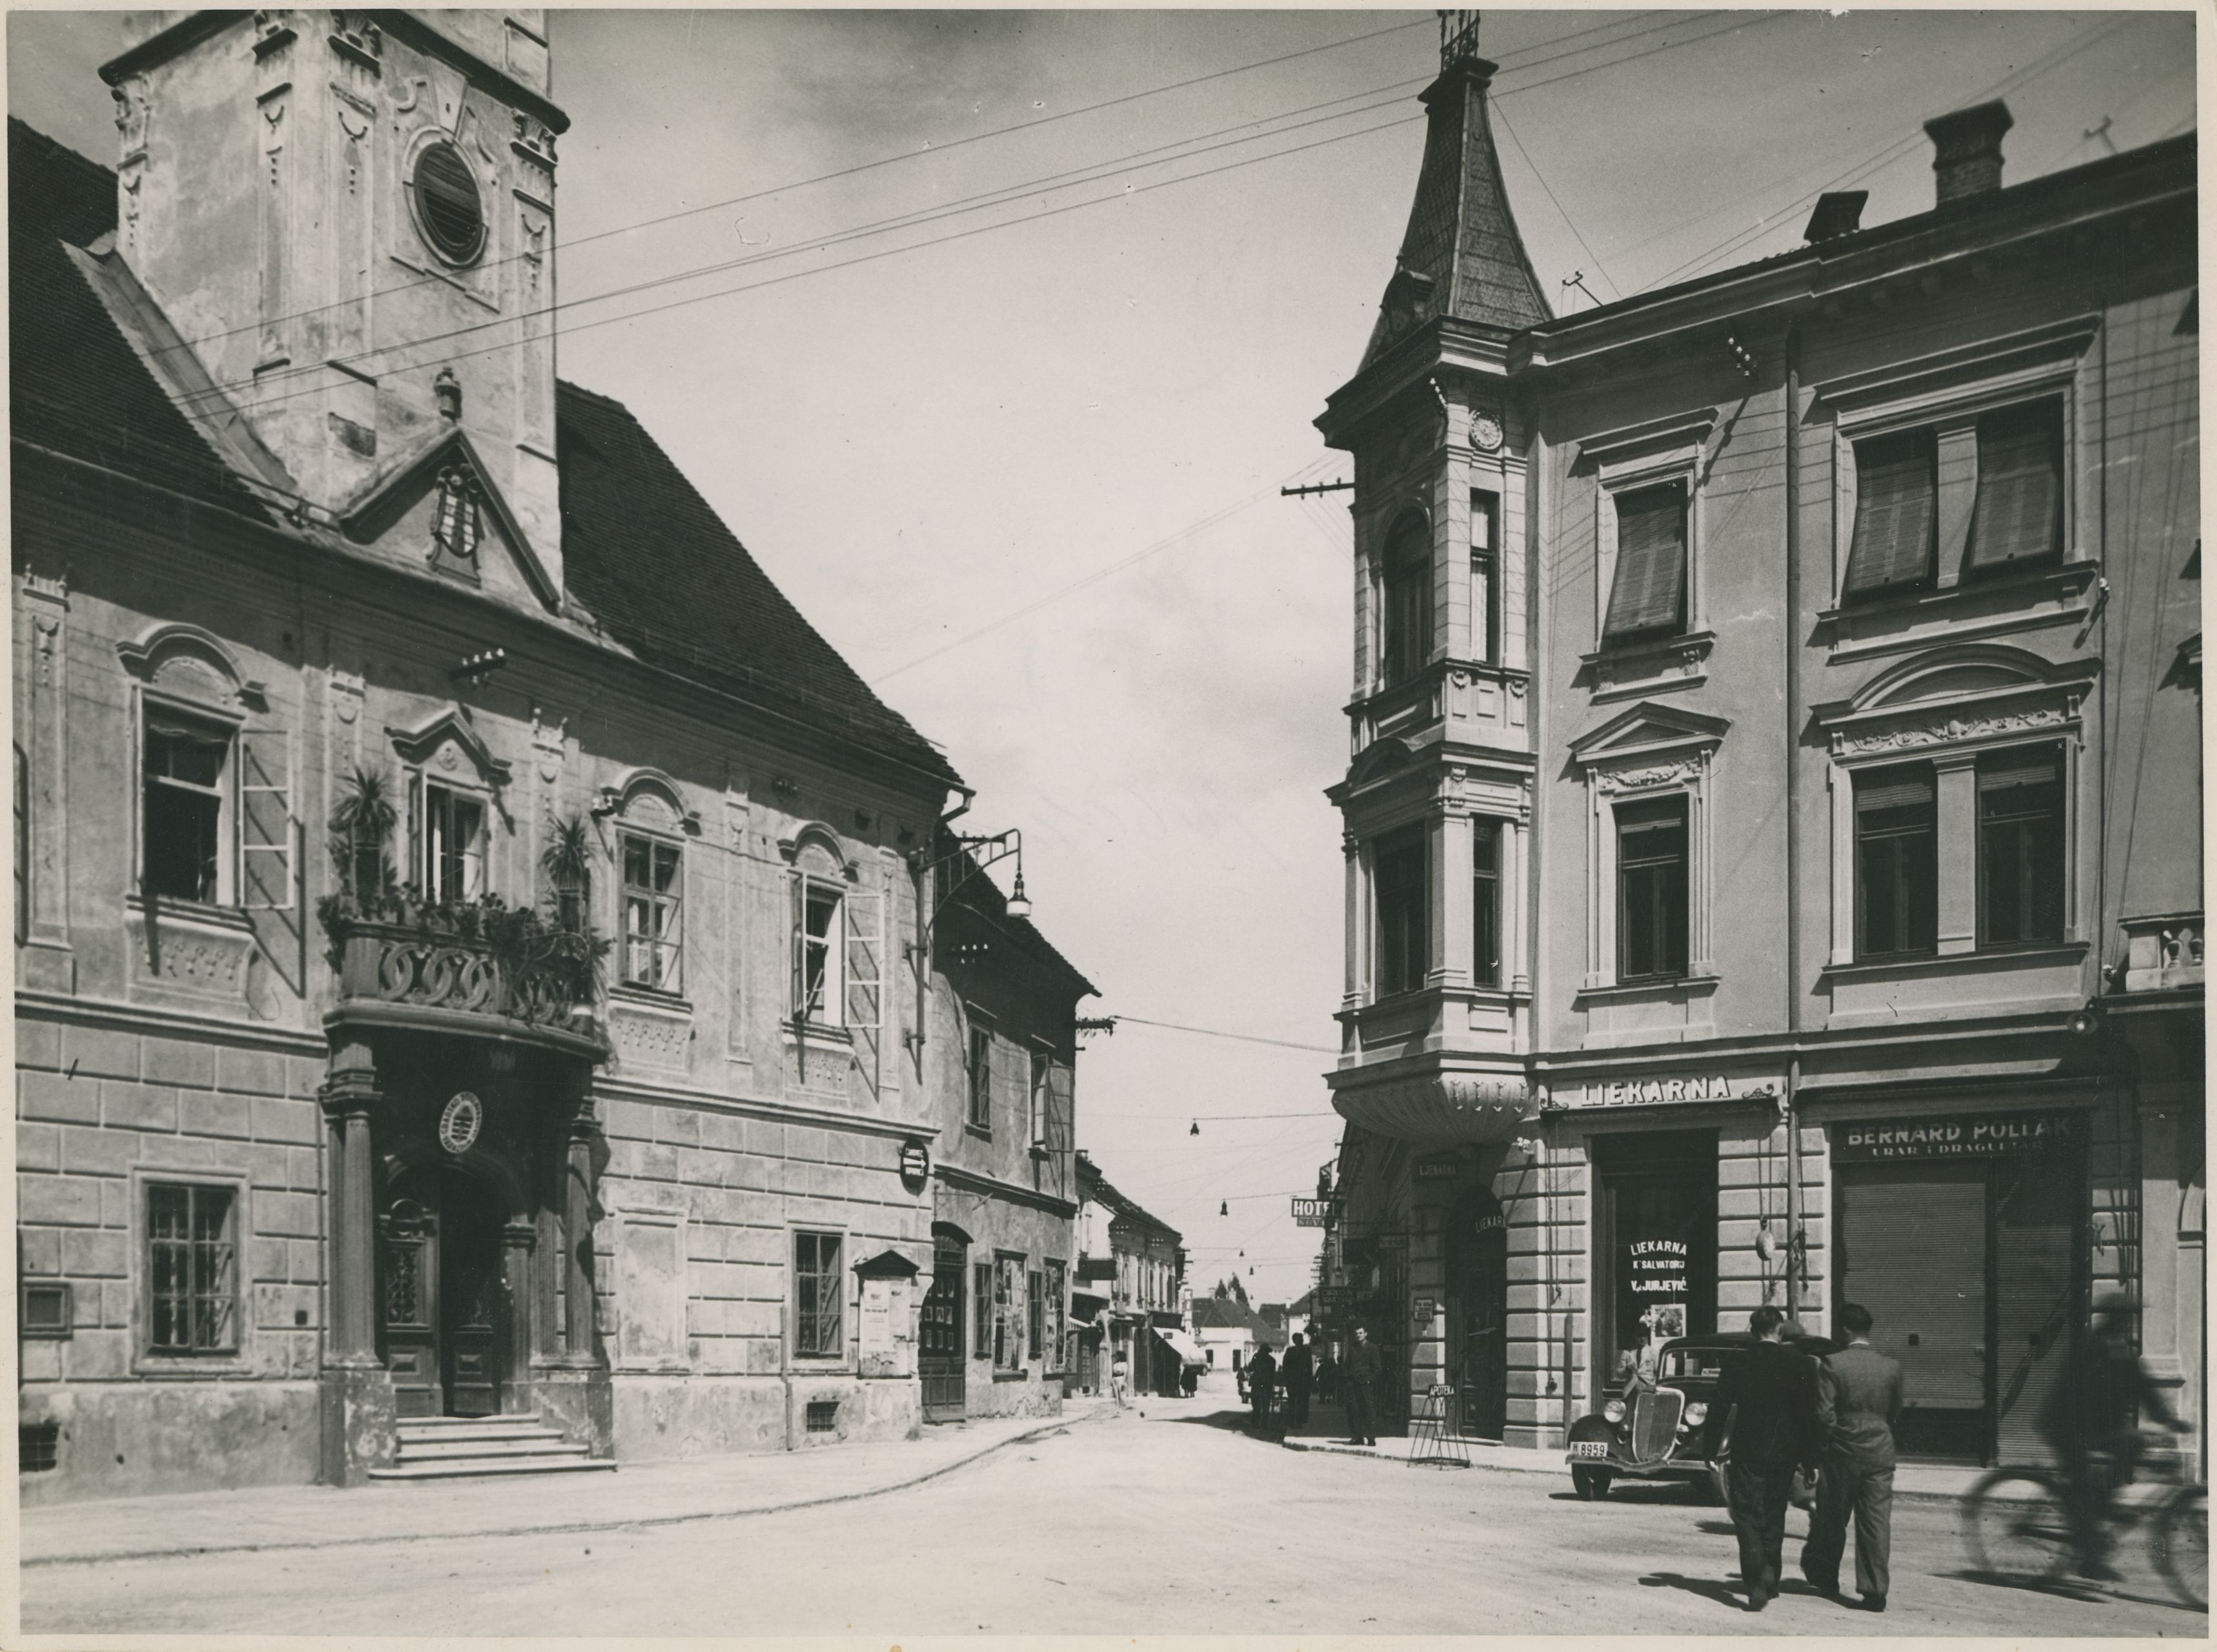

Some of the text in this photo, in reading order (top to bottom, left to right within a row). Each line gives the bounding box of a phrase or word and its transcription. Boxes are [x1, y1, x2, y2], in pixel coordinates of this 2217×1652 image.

[1848, 1116, 2071, 1145] BERNARD POLLAK
[1581, 1444, 1605, 1456] 8959
